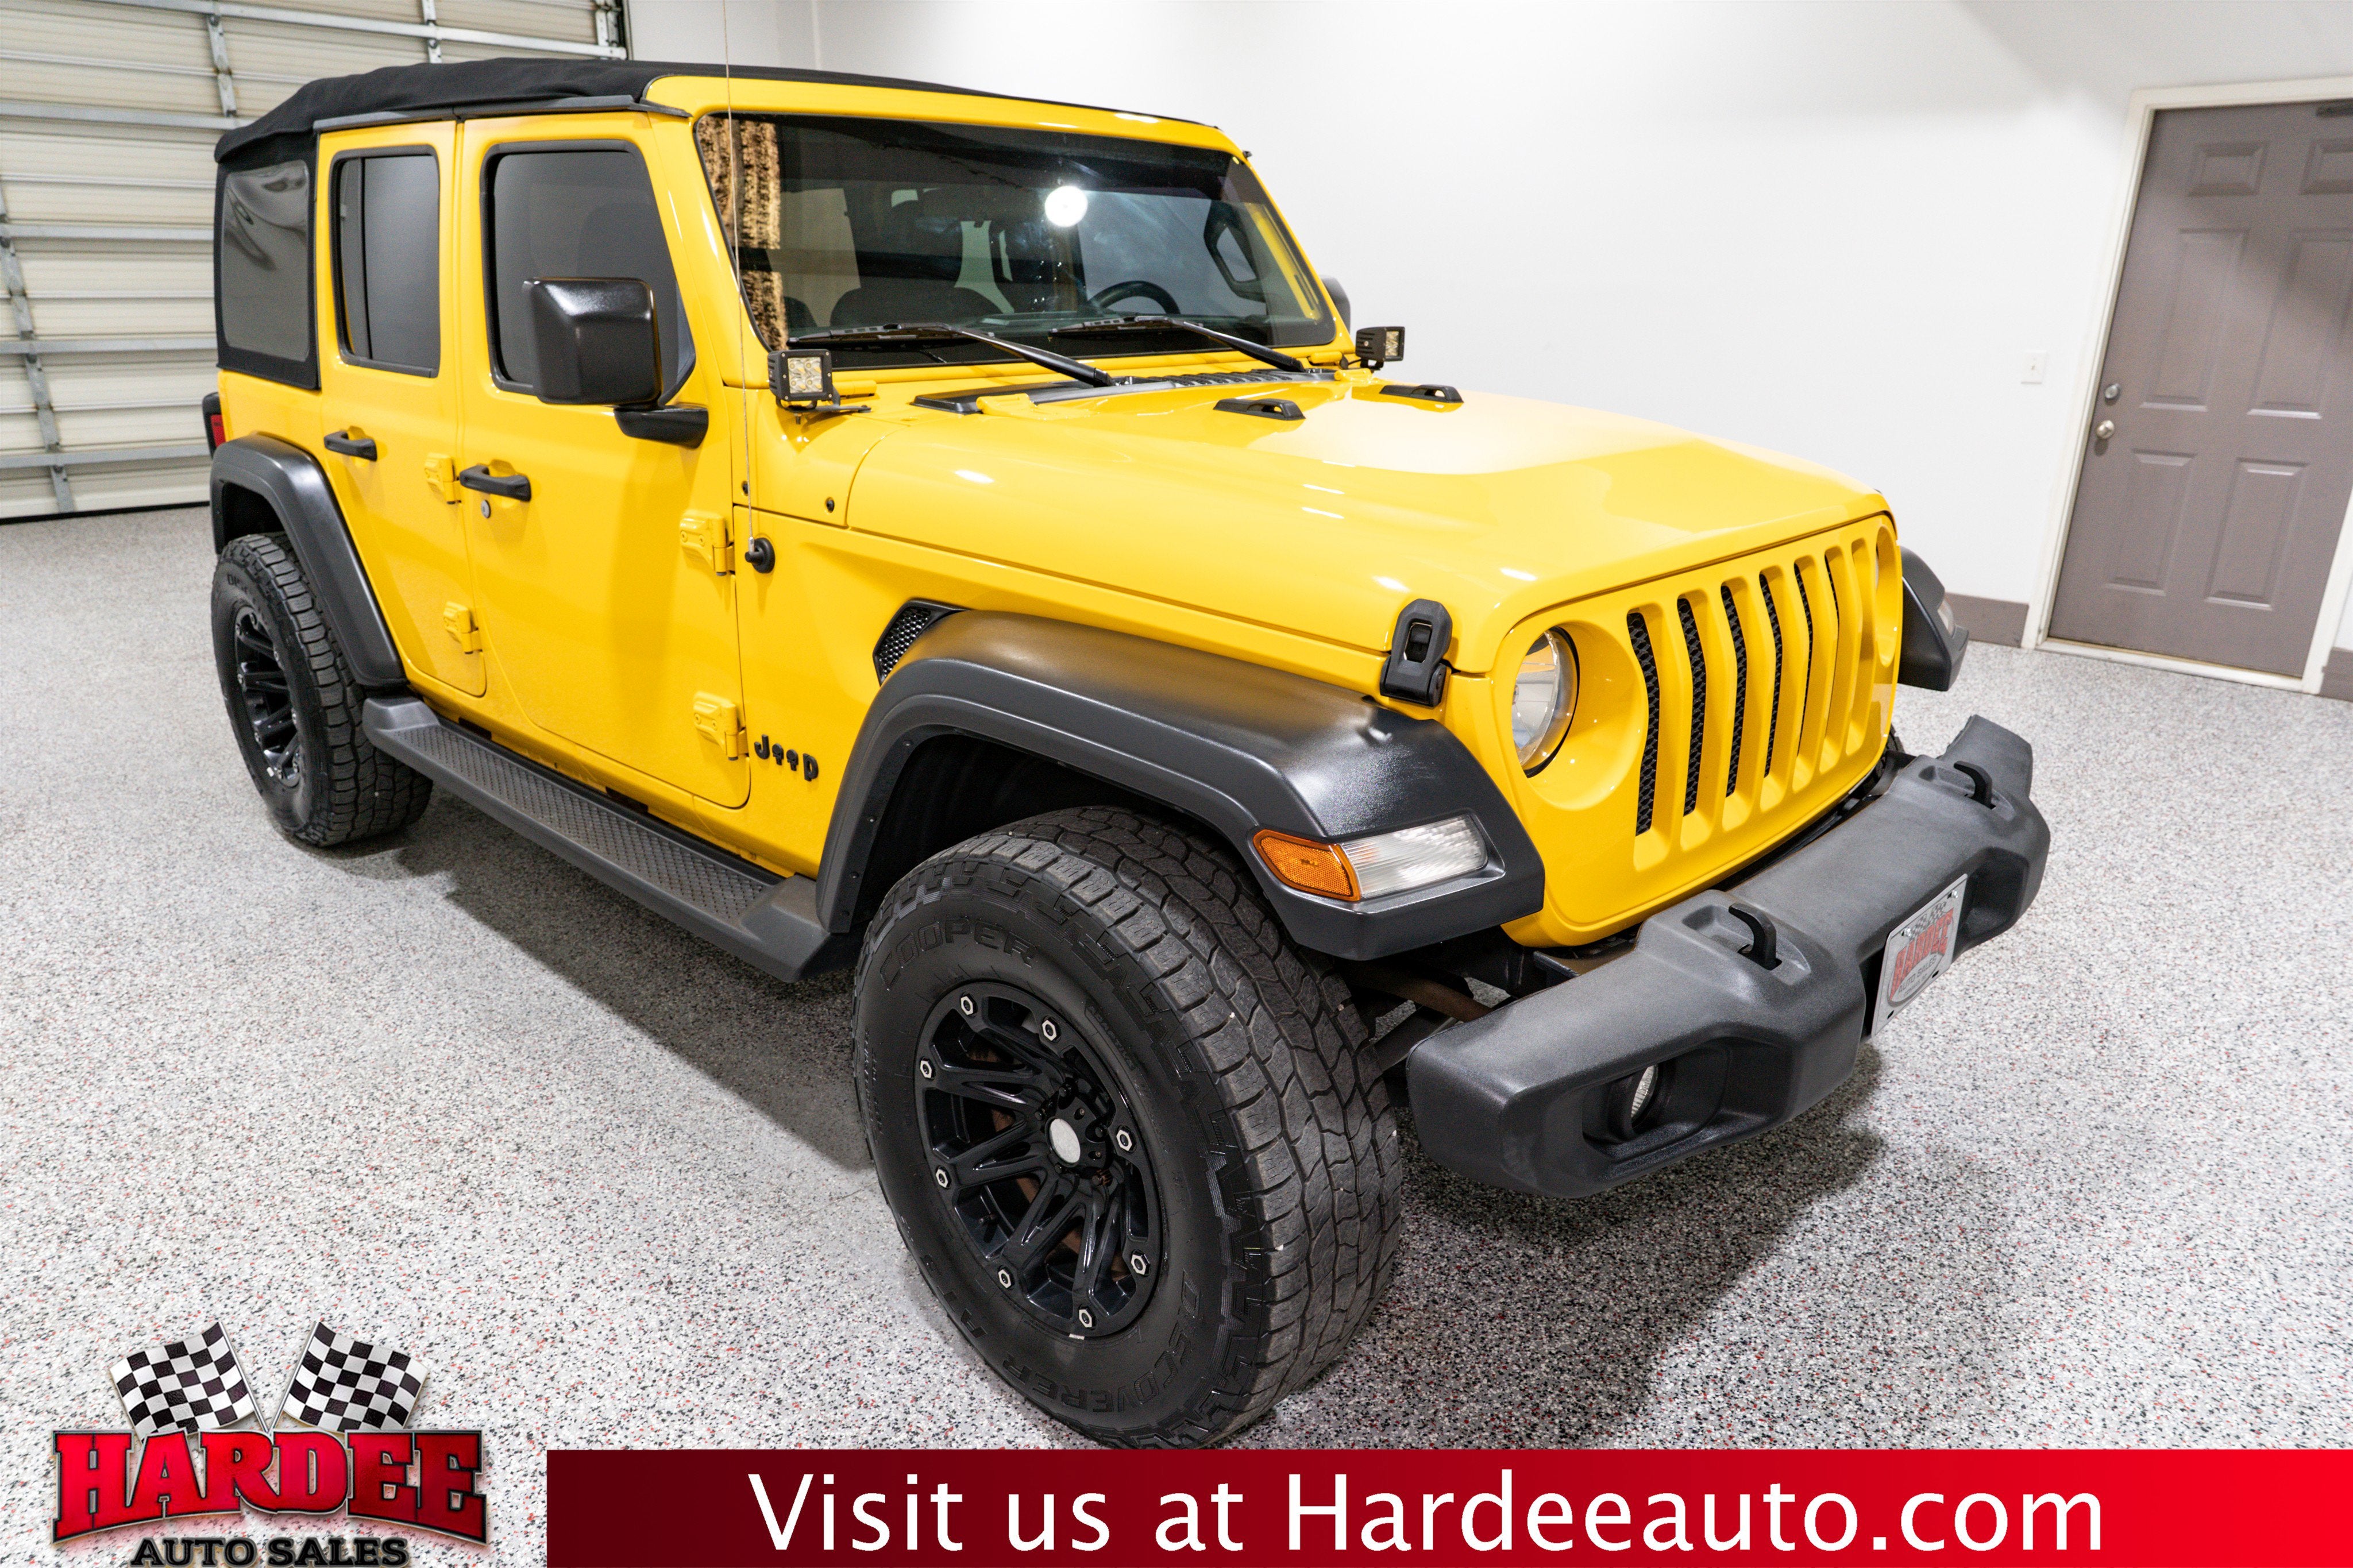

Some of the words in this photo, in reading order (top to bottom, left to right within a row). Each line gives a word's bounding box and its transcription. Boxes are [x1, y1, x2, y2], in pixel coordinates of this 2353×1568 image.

[880, 914, 1037, 991] COOPER
[1891, 907, 1954, 1001] HARDEE
[1899, 973, 1916, 994] AUTO
[1917, 954, 1938, 978] SALES
